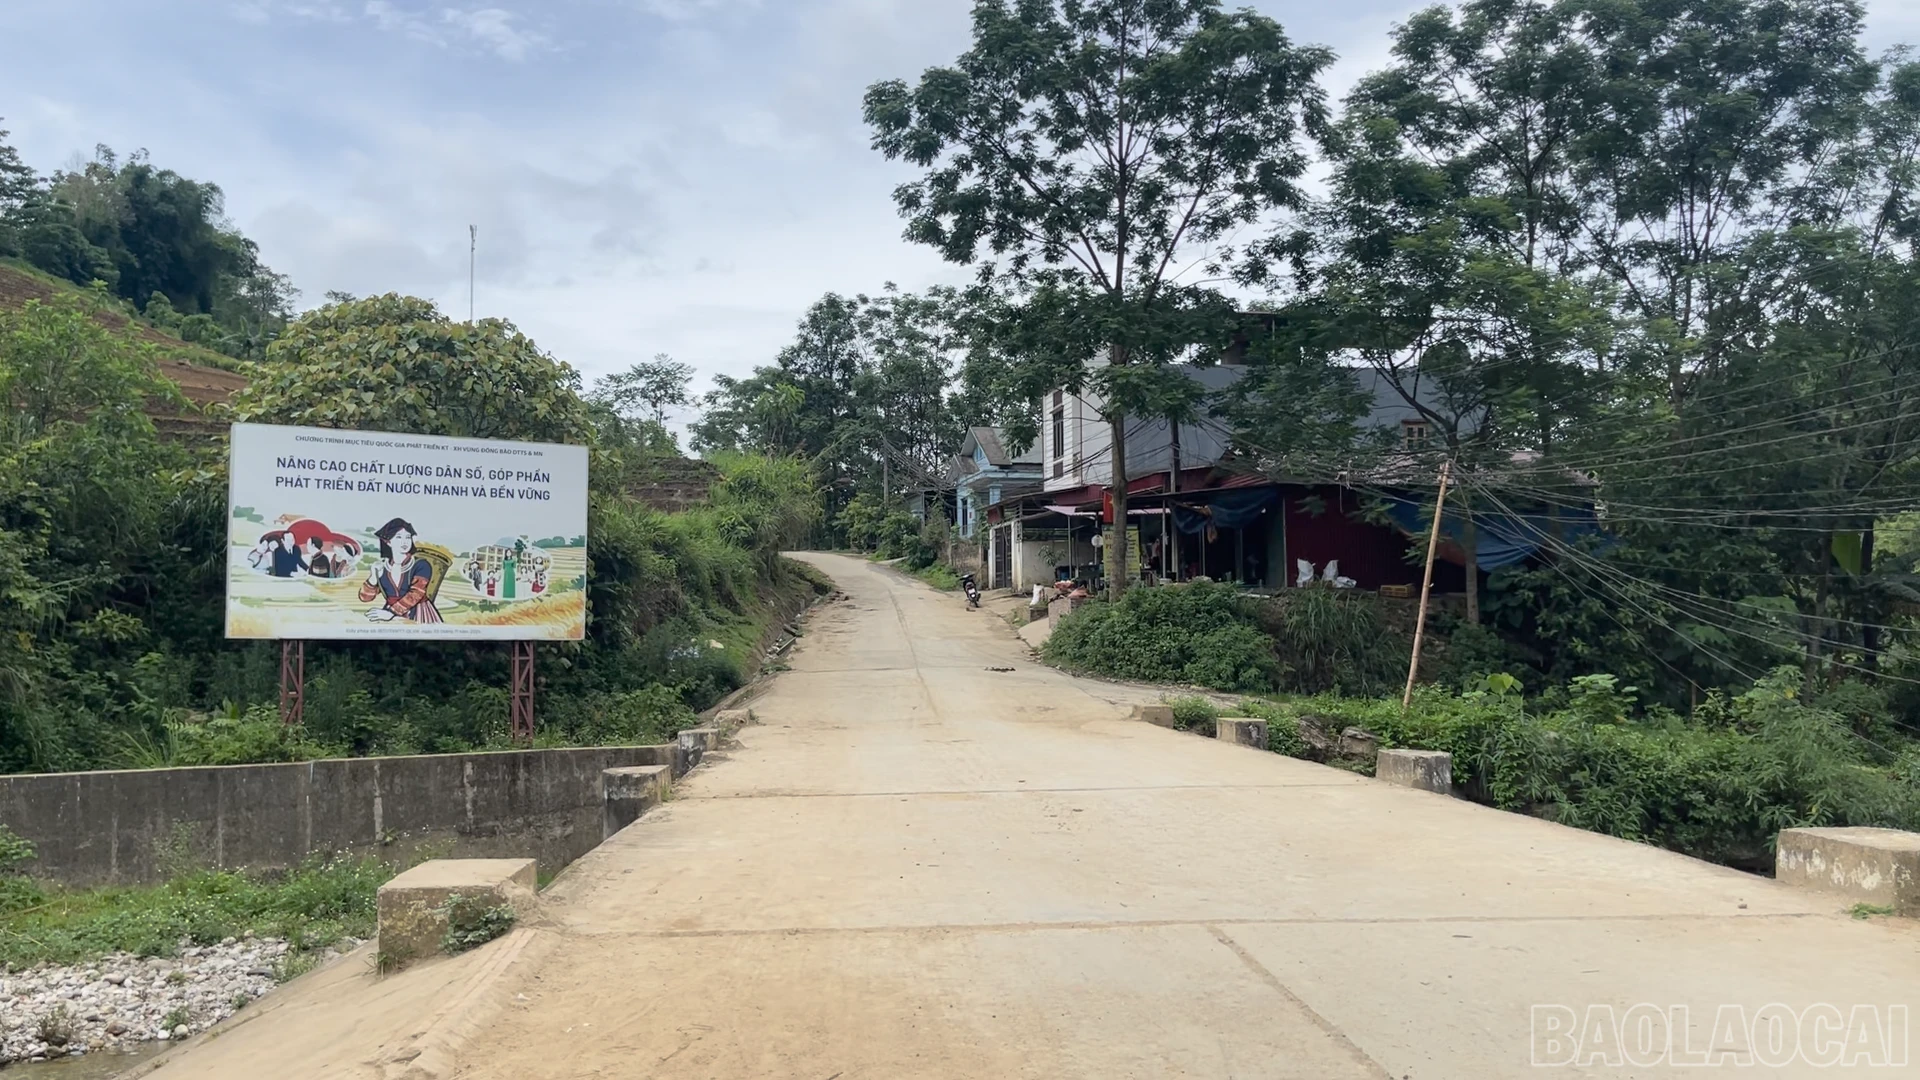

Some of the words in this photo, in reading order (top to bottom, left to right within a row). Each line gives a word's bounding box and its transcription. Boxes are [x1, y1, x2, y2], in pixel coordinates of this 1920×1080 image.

[276, 455, 316, 470] NÂNG
[320, 460, 347, 472] CAO
[350, 460, 385, 474] CHẤT
[388, 463, 432, 478] LƯỢNG
[436, 464, 462, 478] DÂN
[465, 466, 485, 481] SỐ,
[489, 468, 514, 482] GÓP
[275, 474, 311, 488] PHÁT
[314, 474, 354, 491] TRIỂN
[357, 478, 382, 492] ĐẤT
[385, 480, 421, 494] NƯỚC
[424, 484, 468, 496] NHANH
[472, 485, 487, 498] VÀ
[518, 487, 551, 501] VỮNG
